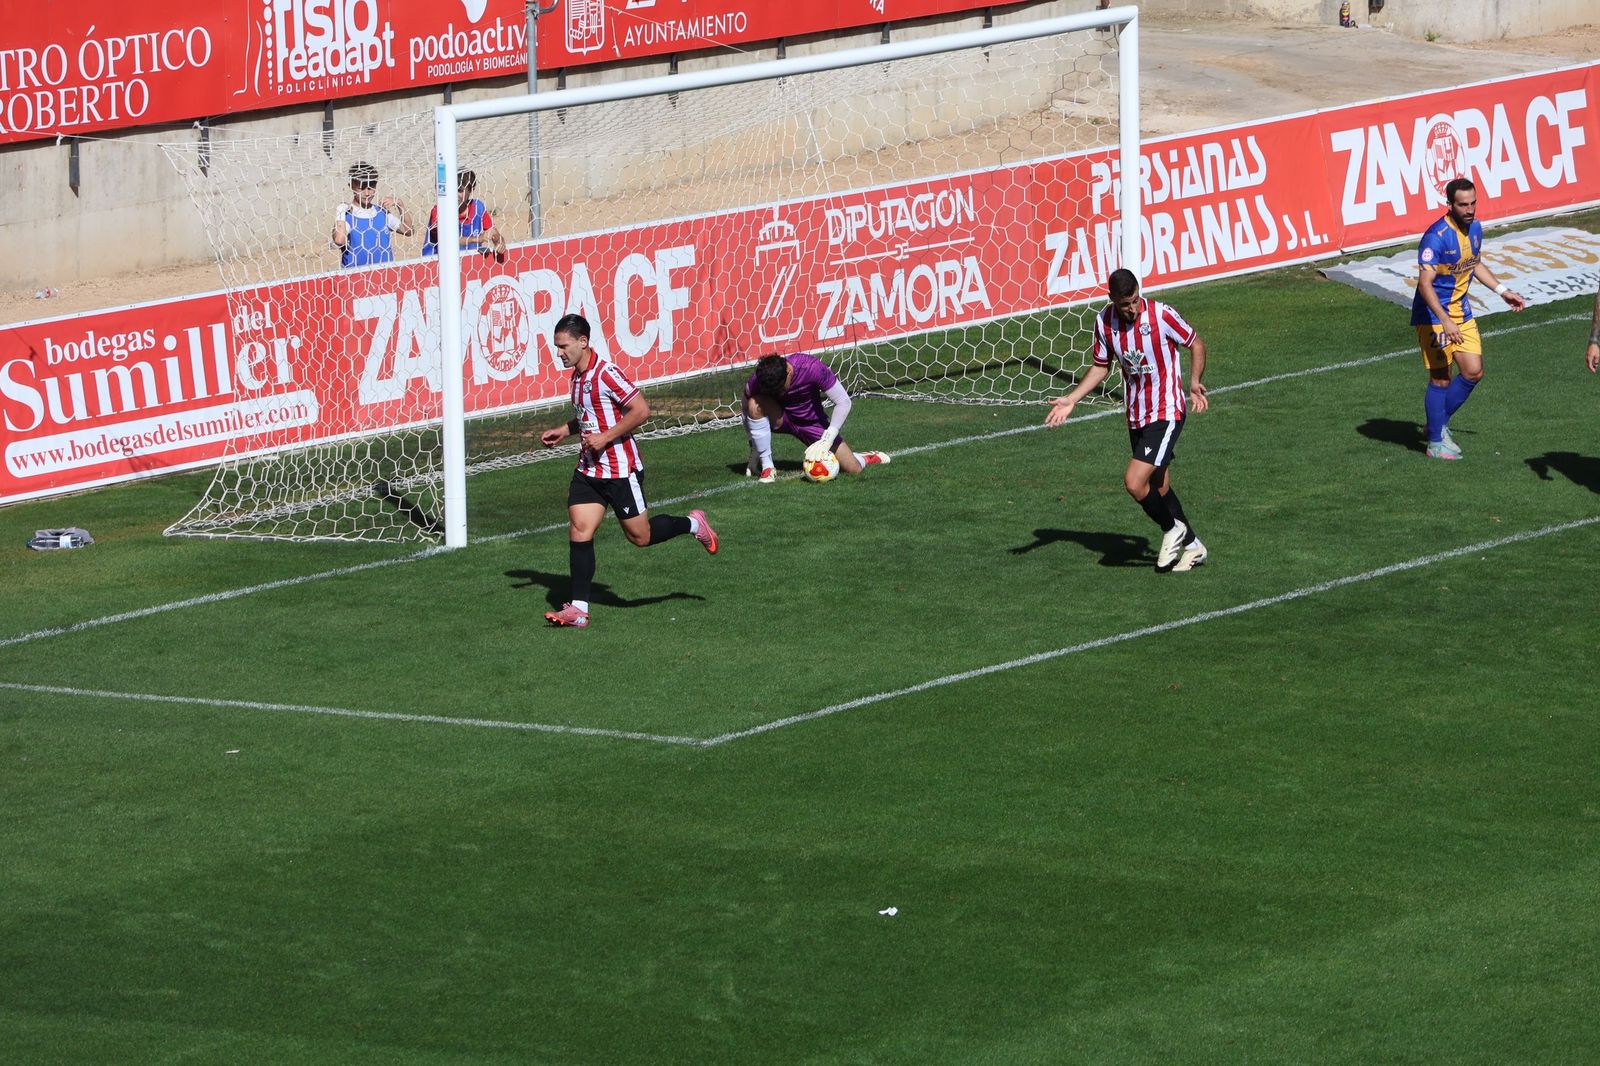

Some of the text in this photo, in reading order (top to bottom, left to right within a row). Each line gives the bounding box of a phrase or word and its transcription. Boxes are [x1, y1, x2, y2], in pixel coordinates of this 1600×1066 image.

[78, 25, 212, 81] ÓPTICO
[276, 22, 395, 83] readapt
[624, 11, 747, 48] AYUNTAMIENTO
[277, 75, 361, 95] POLICLÍNICA
[427, 57, 474, 78] PODOLOGÍA
[475, 58, 482, 71] Y
[1330, 88, 1587, 226] ZAMORA CF
[1282, 210, 1329, 251] S.L.
[352, 244, 696, 406] ZAMORA CF
[816, 255, 991, 340] ZAMORA
[44, 302, 273, 366] bodegas del
[0, 322, 301, 432] Sumiller
[12, 401, 309, 471] www.bodegasdelsumiller.com
